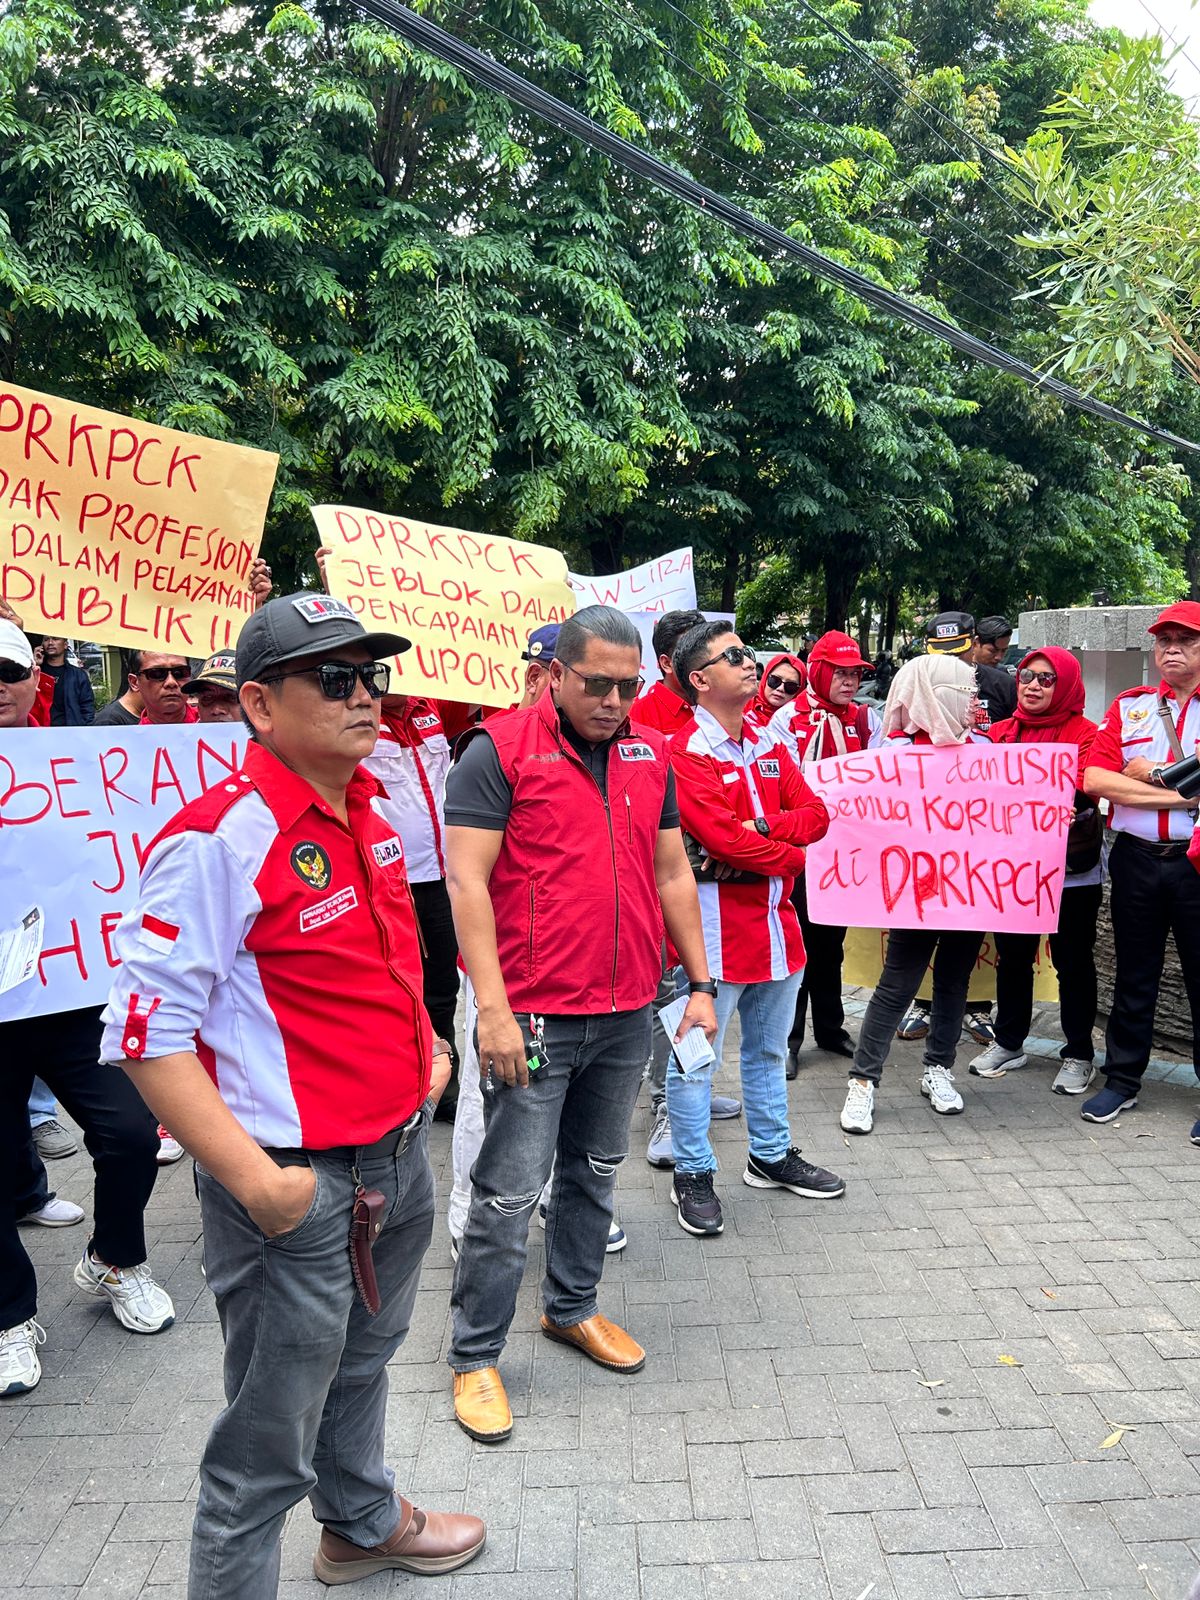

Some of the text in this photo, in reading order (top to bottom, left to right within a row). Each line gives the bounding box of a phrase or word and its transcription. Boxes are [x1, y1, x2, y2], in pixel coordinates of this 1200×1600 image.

[12, 523, 120, 583] DALAM
[78, 493, 255, 580] PROFESION
[335, 511, 543, 579] DPRKPCK
[2, 562, 193, 645] PUBLIK
[341, 559, 489, 607] JEBLOK
[347, 595, 519, 649] PENCAPAIAN
[817, 752, 934, 789] USUT
[921, 795, 1071, 838] KORUPTOR
[880, 844, 1060, 922] DPRKPCK
